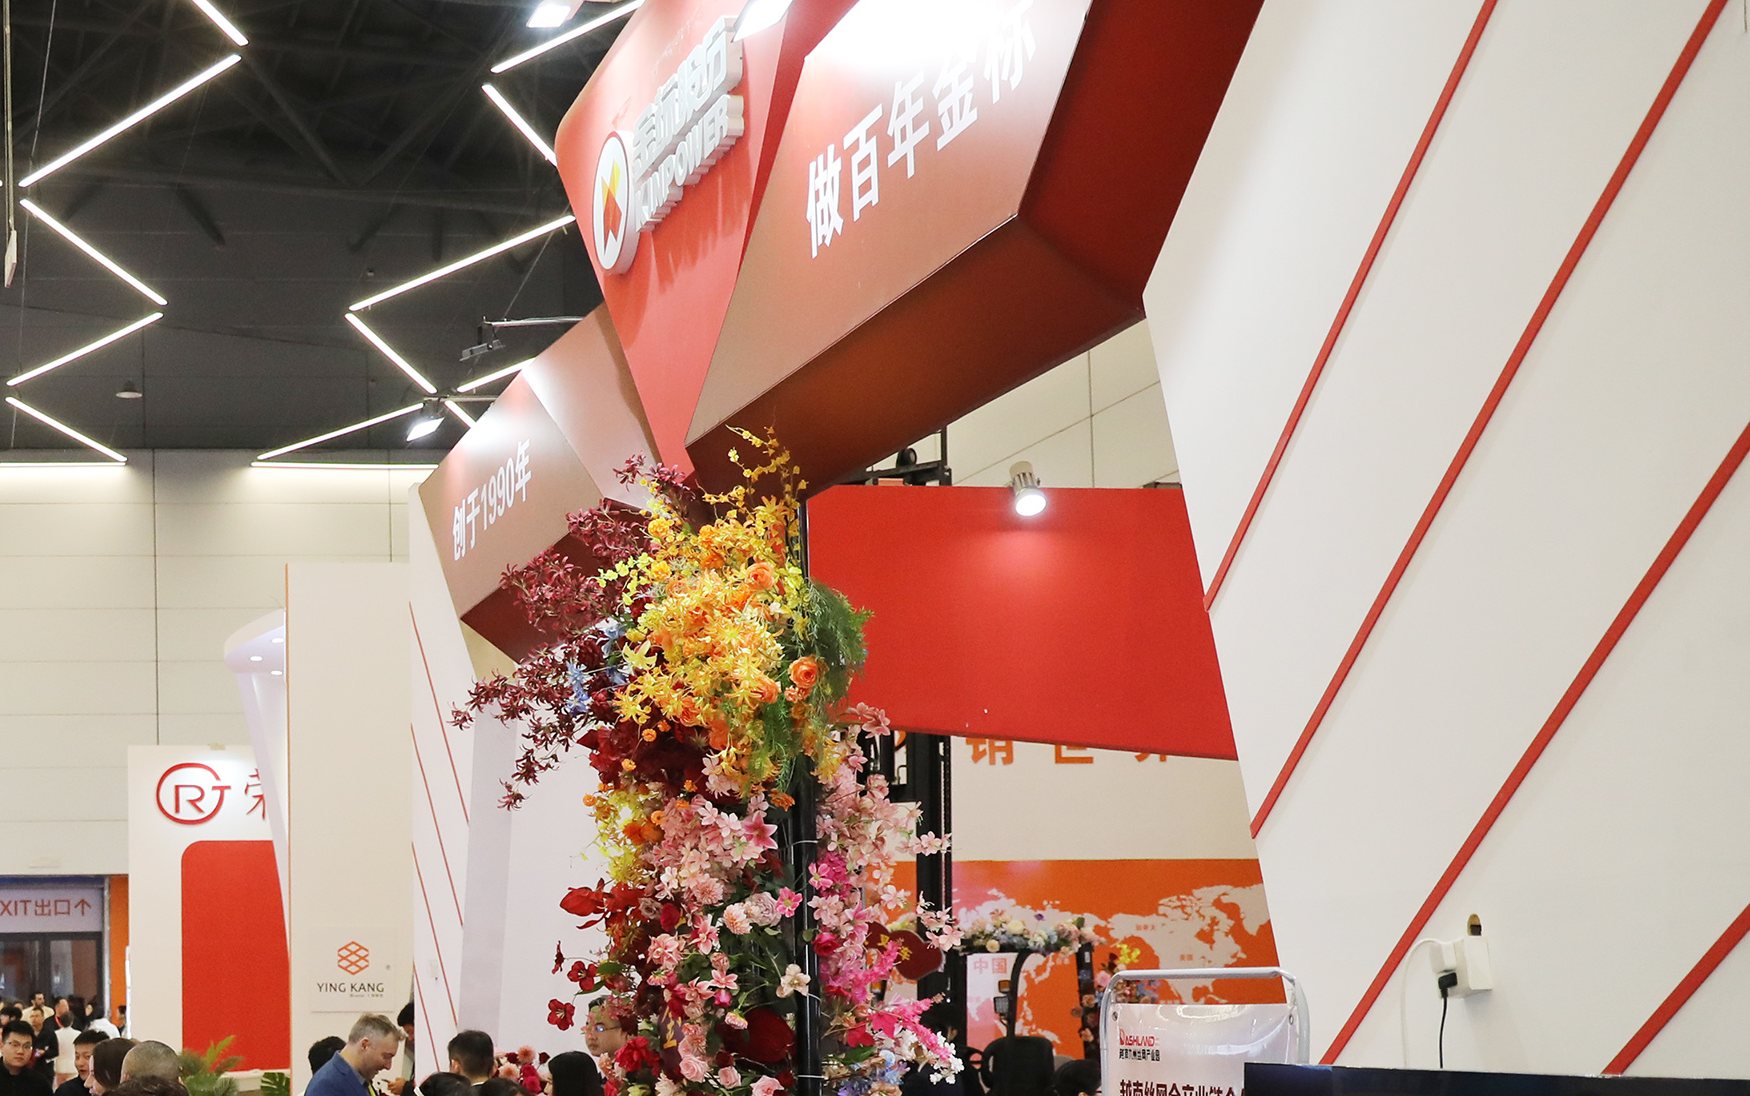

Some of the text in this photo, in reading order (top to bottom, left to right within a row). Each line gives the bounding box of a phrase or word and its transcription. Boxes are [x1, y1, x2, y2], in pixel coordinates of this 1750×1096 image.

[635, 94, 732, 232] KINPOWER
[452, 437, 533, 563] 创于1990年
[317, 982, 385, 993] YING KANG
[973, 958, 1007, 974] 中国
